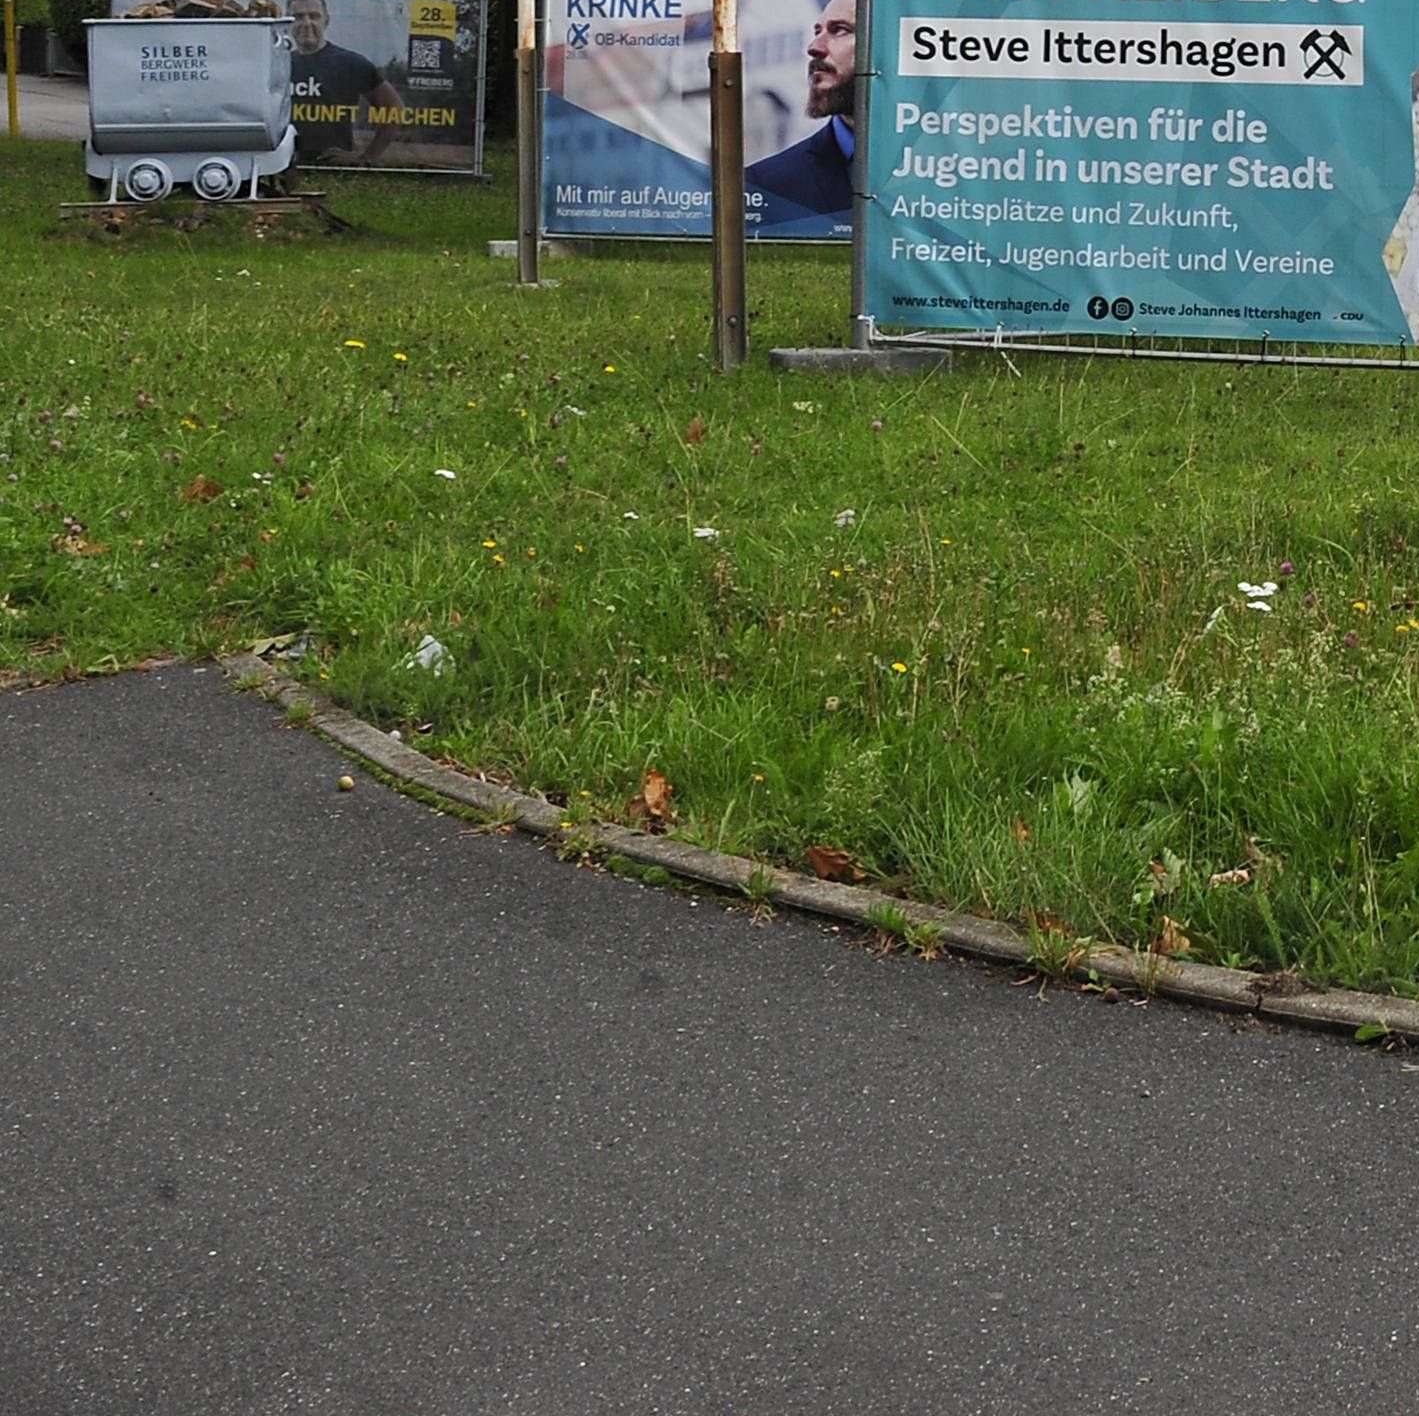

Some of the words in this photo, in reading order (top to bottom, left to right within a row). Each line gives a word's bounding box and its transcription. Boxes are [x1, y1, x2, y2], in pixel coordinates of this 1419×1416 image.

[420, 7, 446, 22] 28.
[595, 33, 680, 46] OB-Kandidat
[142, 46, 207, 58] SILBER
[913, 27, 1030, 63] Steve
[1043, 28, 1286, 76] Ittershagen
[141, 59, 207, 70] BERGWERK
[141, 71, 209, 81] FREIBERG
[293, 104, 359, 122] KUNFT
[368, 106, 456, 126] MACHEN
[896, 102, 1138, 144] Perspektiven
[1147, 108, 1203, 142] für
[1212, 110, 1267, 143] die
[893, 147, 1025, 188] Jugend
[1035, 150, 1067, 183] in
[1078, 157, 1218, 187] unserer
[1227, 155, 1334, 191] Stadt
[556, 185, 582, 203] Mit
[587, 186, 615, 203] mir
[621, 186, 649, 204] auf
[653, 188, 768, 210] Augene.
[891, 194, 1064, 227] Arbeitsplätze
[1072, 202, 1120, 225] und
[1129, 202, 1238, 233] Zukunft,
[891, 238, 992, 267] Freizeit,
[999, 242, 1170, 271] Jugendarbeit
[1178, 247, 1227, 272] und
[1235, 249, 1335, 275] Vereine
[892, 295, 1070, 314] www.steveittershagen.de
[1139, 302, 1176, 316] Steve
[1178, 304, 1240, 318] Johannes
[1244, 307, 1321, 323] Ittershagen
[1340, 312, 1364, 321] CDU
